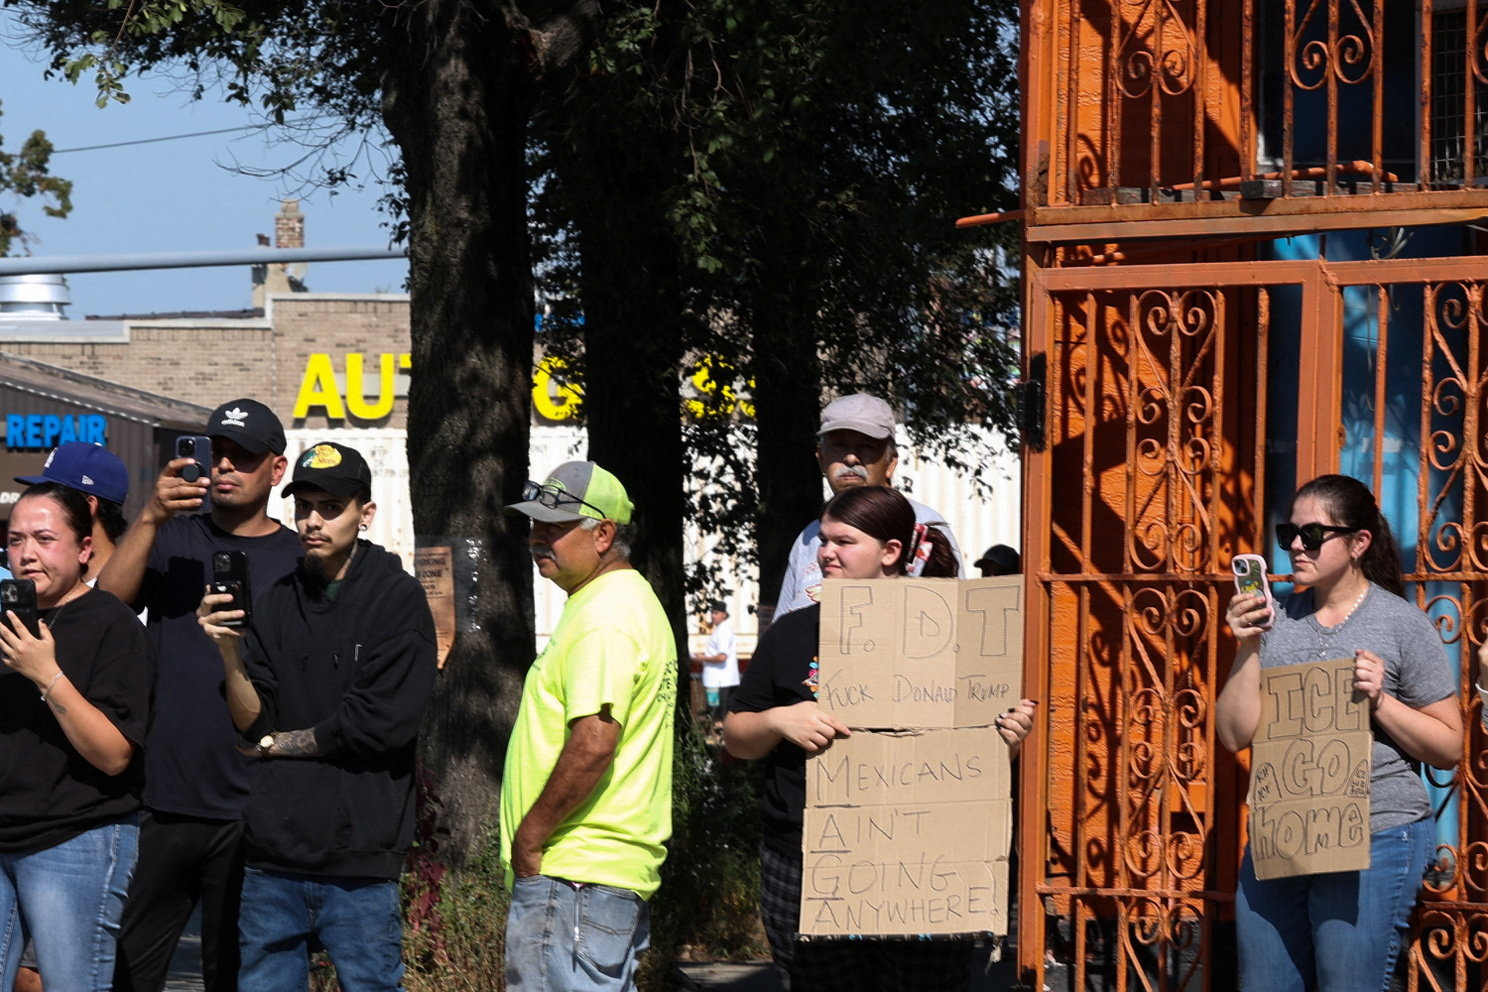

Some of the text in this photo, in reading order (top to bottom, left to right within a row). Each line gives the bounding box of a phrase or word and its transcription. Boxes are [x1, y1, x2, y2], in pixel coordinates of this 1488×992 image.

[6, 413, 106, 448] REPAIR
[823, 668, 1011, 711] FUCK DONALD TRUMP
[1267, 667, 1362, 740] ICE
[816, 752, 983, 800] MEXICANS
[1281, 738, 1352, 798] GO
[818, 809, 931, 848] AIN'T
[812, 852, 957, 895] GOING
